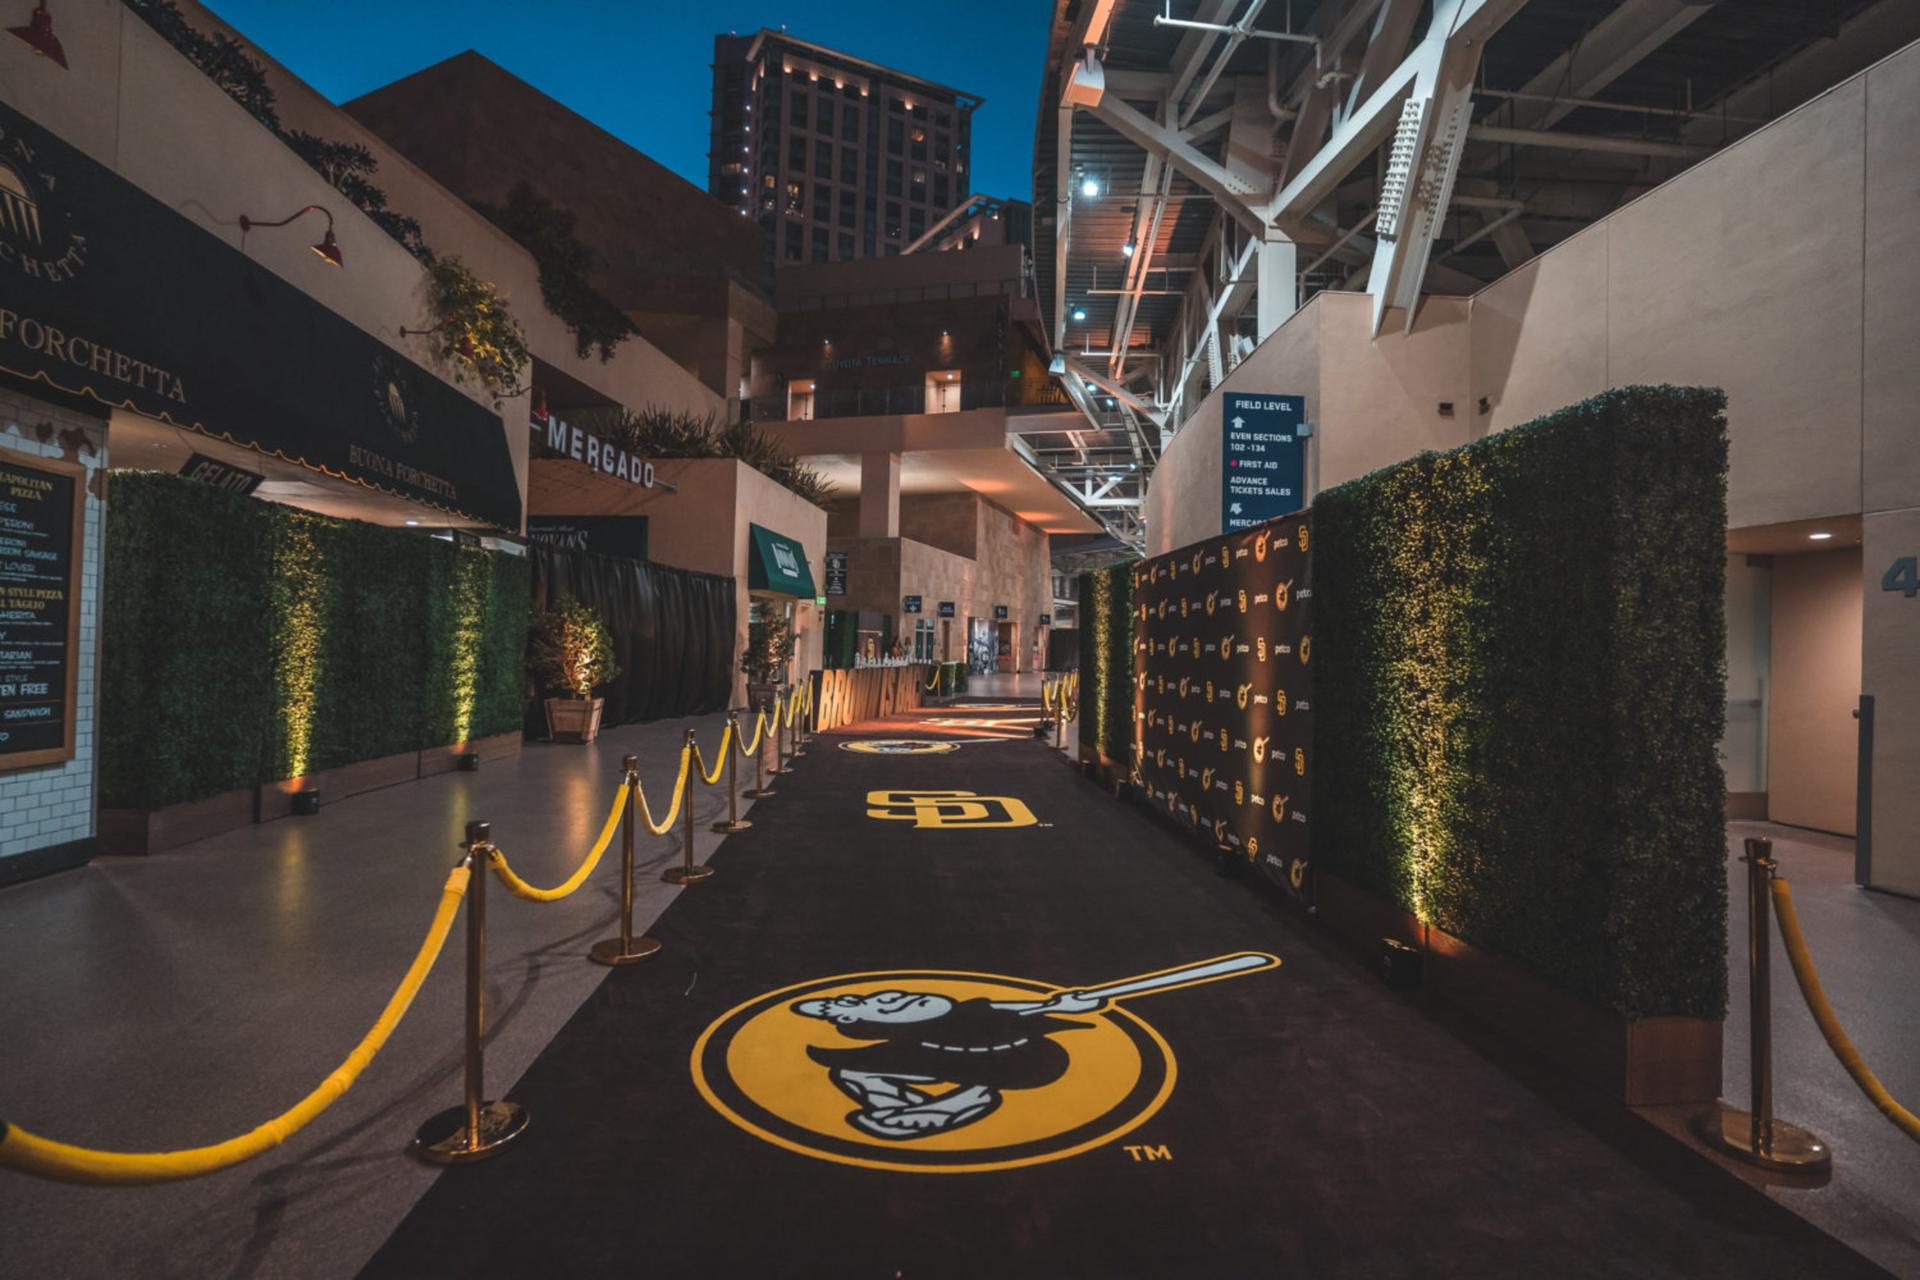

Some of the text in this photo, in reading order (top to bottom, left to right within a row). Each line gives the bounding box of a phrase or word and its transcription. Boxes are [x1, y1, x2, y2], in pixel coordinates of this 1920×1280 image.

[0, 308, 187, 404] FORCHETTA
[1235, 400, 1293, 411] FIELD LEVEL
[1230, 432, 1293, 443] EVEN SECTIONS
[1230, 443, 1246, 451] 102
[1239, 460, 1279, 470] FIRST AID
[1230, 476, 1268, 486] ADVANCE
[10, 486, 42, 502] PIZZA
[1230, 486, 1292, 497] TICKETS SALES
[36, 590, 64, 602] PIZZA
[20, 682, 49, 696] FREE
[1124, 1144, 1173, 1162] TM
